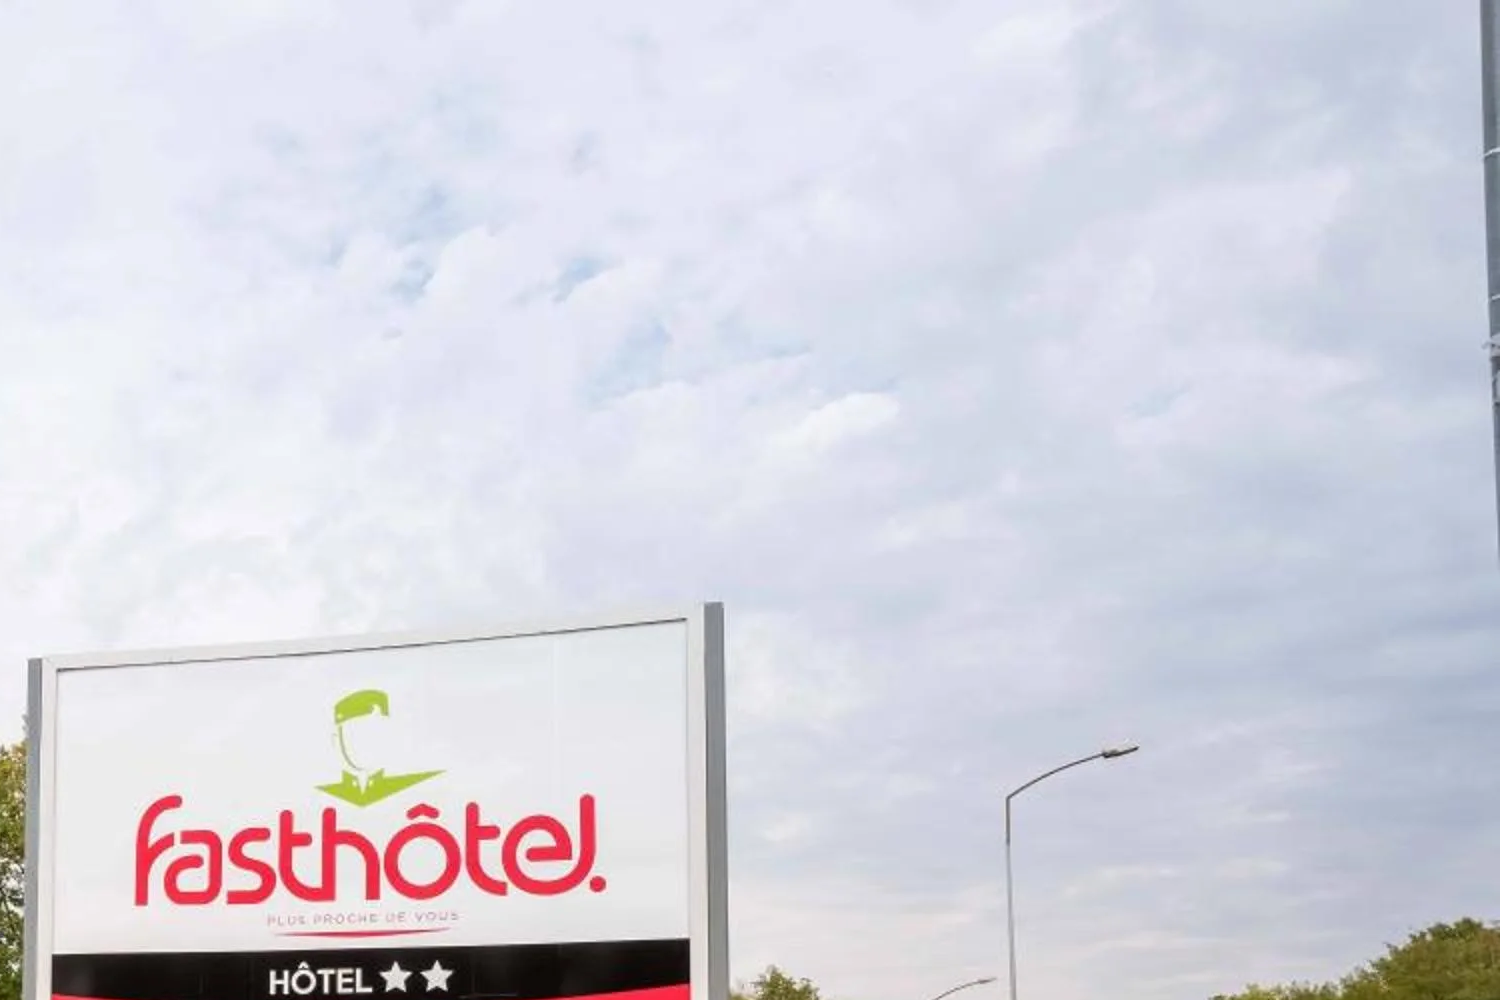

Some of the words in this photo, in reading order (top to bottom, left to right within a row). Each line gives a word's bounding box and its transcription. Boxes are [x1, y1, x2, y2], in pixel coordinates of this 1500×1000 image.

[267, 914, 307, 926] PLUS
[313, 914, 378, 925] PROCHE
[385, 911, 406, 923] DE
[414, 910, 460, 922] VOUS
[268, 961, 373, 996] HÔTEL
